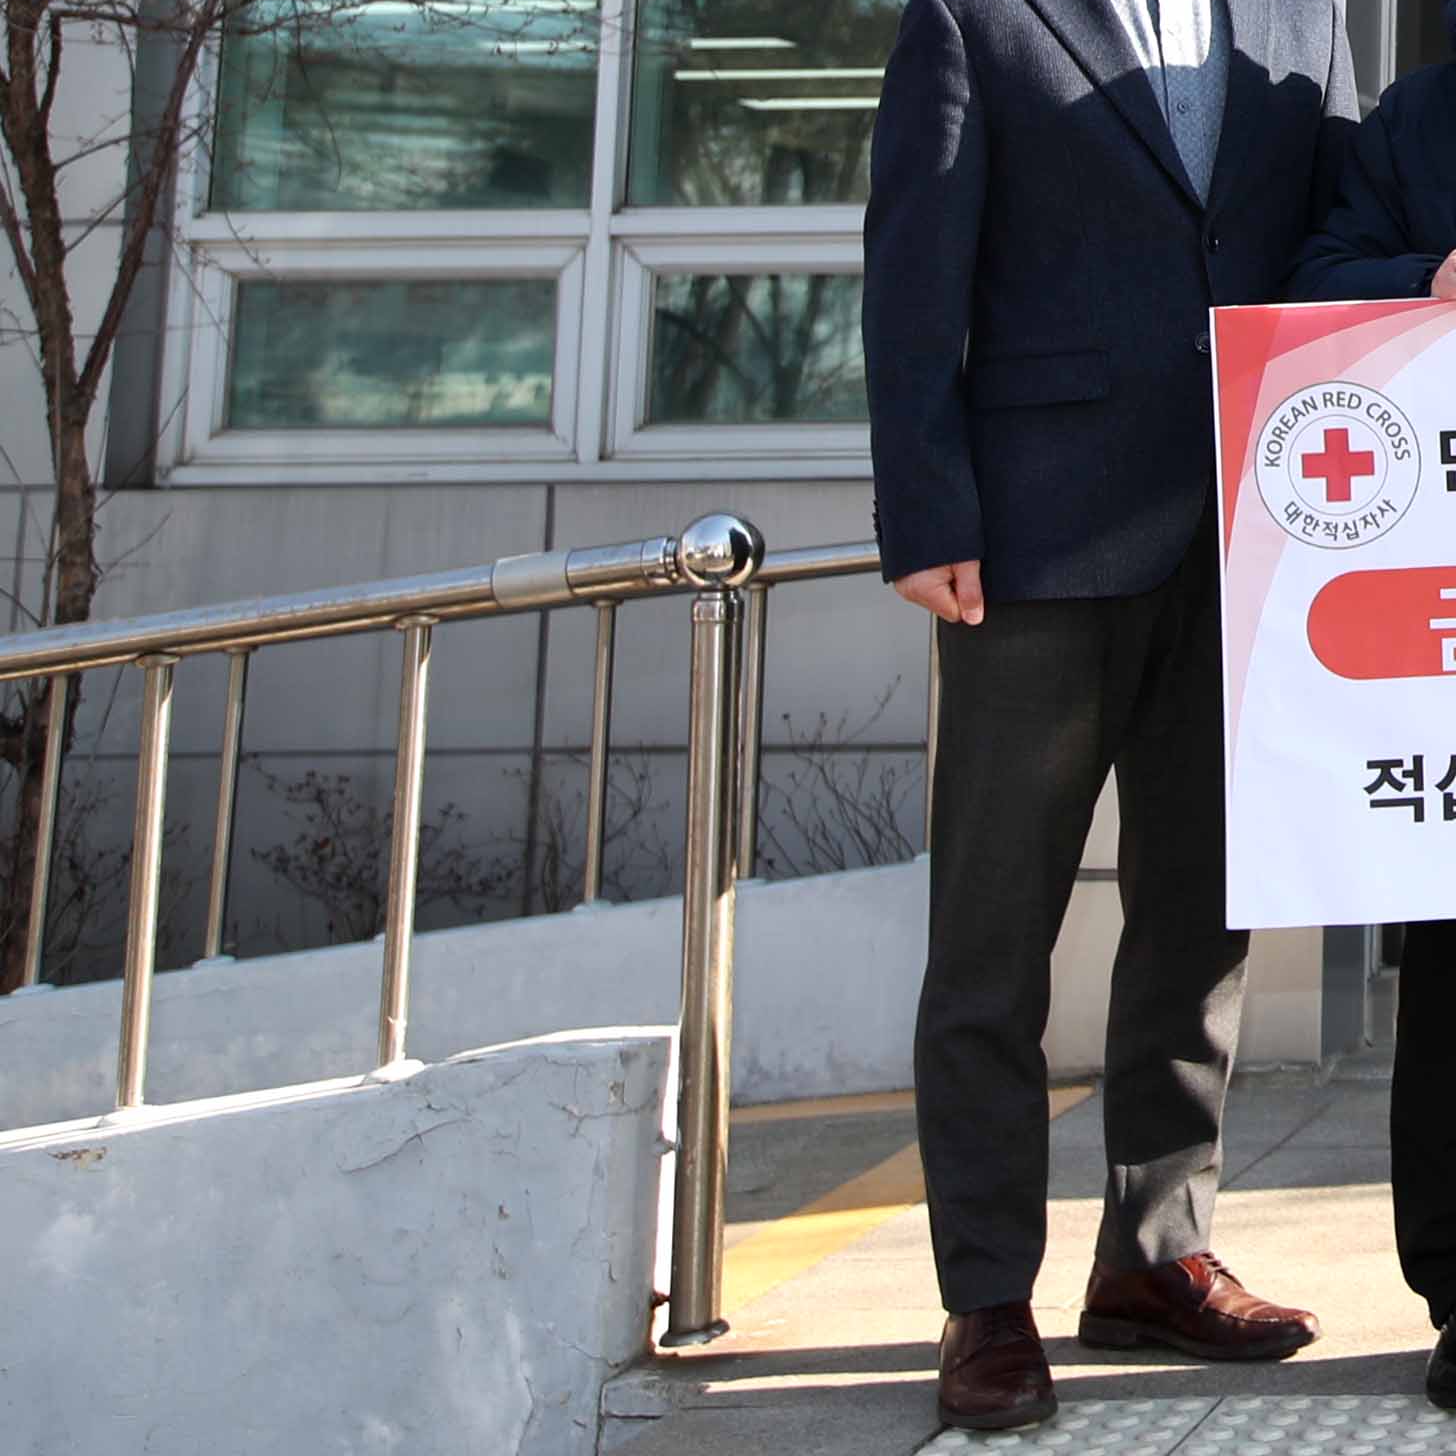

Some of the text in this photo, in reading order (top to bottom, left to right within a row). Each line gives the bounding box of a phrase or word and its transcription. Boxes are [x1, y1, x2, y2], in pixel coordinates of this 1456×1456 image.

[1264, 391, 1412, 468] KOREAN RED CROSS
[1284, 498, 1398, 542] 대한적십자사
